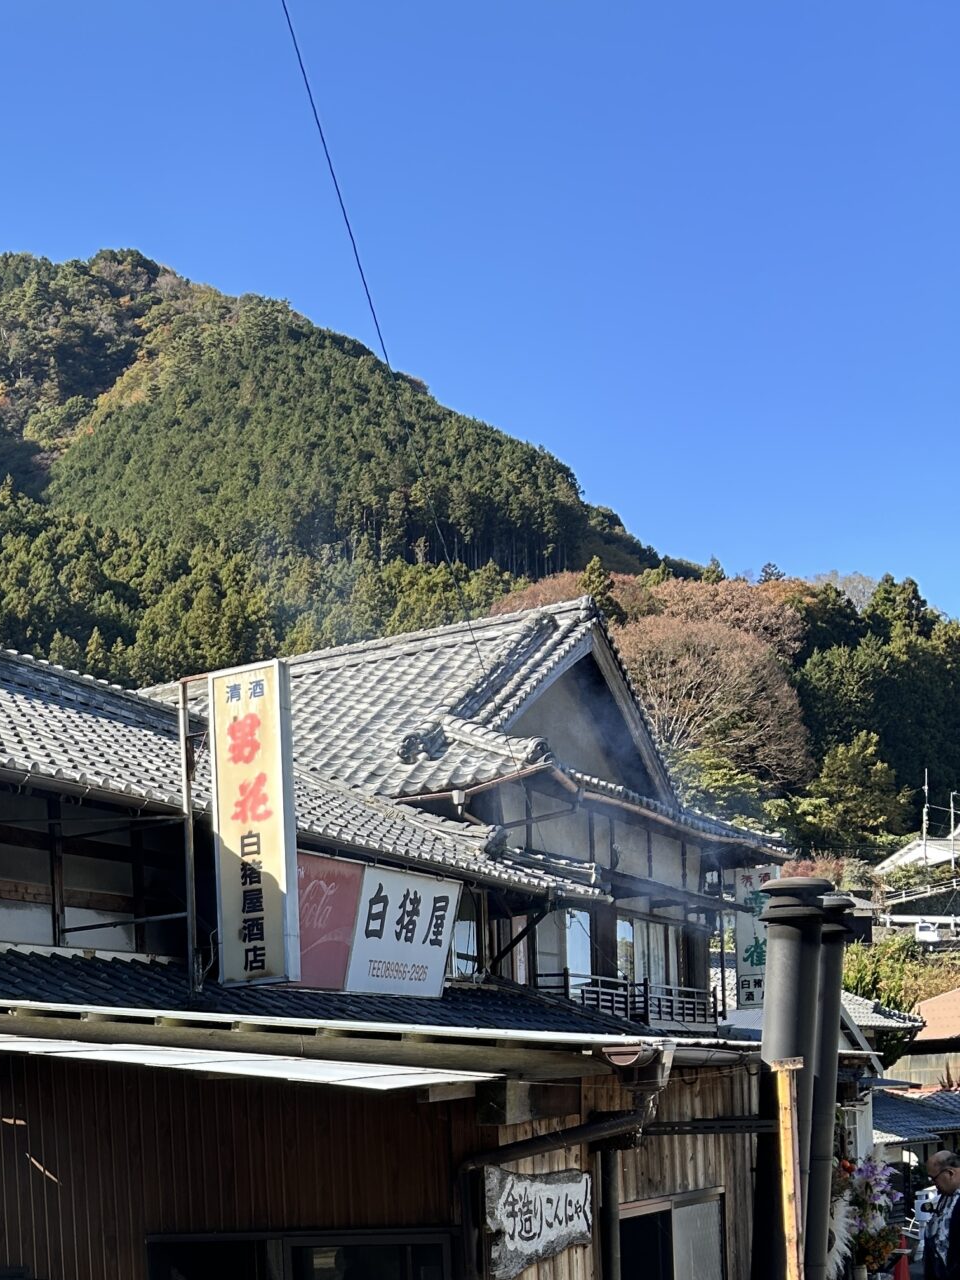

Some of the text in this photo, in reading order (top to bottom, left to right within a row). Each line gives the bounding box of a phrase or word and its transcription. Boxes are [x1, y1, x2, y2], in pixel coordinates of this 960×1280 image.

[226, 679, 265, 703] 清酒
[240, 830, 266, 972] 白猪屋酒店
[364, 882, 450, 948] 白猪屋
[503, 1177, 591, 1241] 手造りこんにゃく
